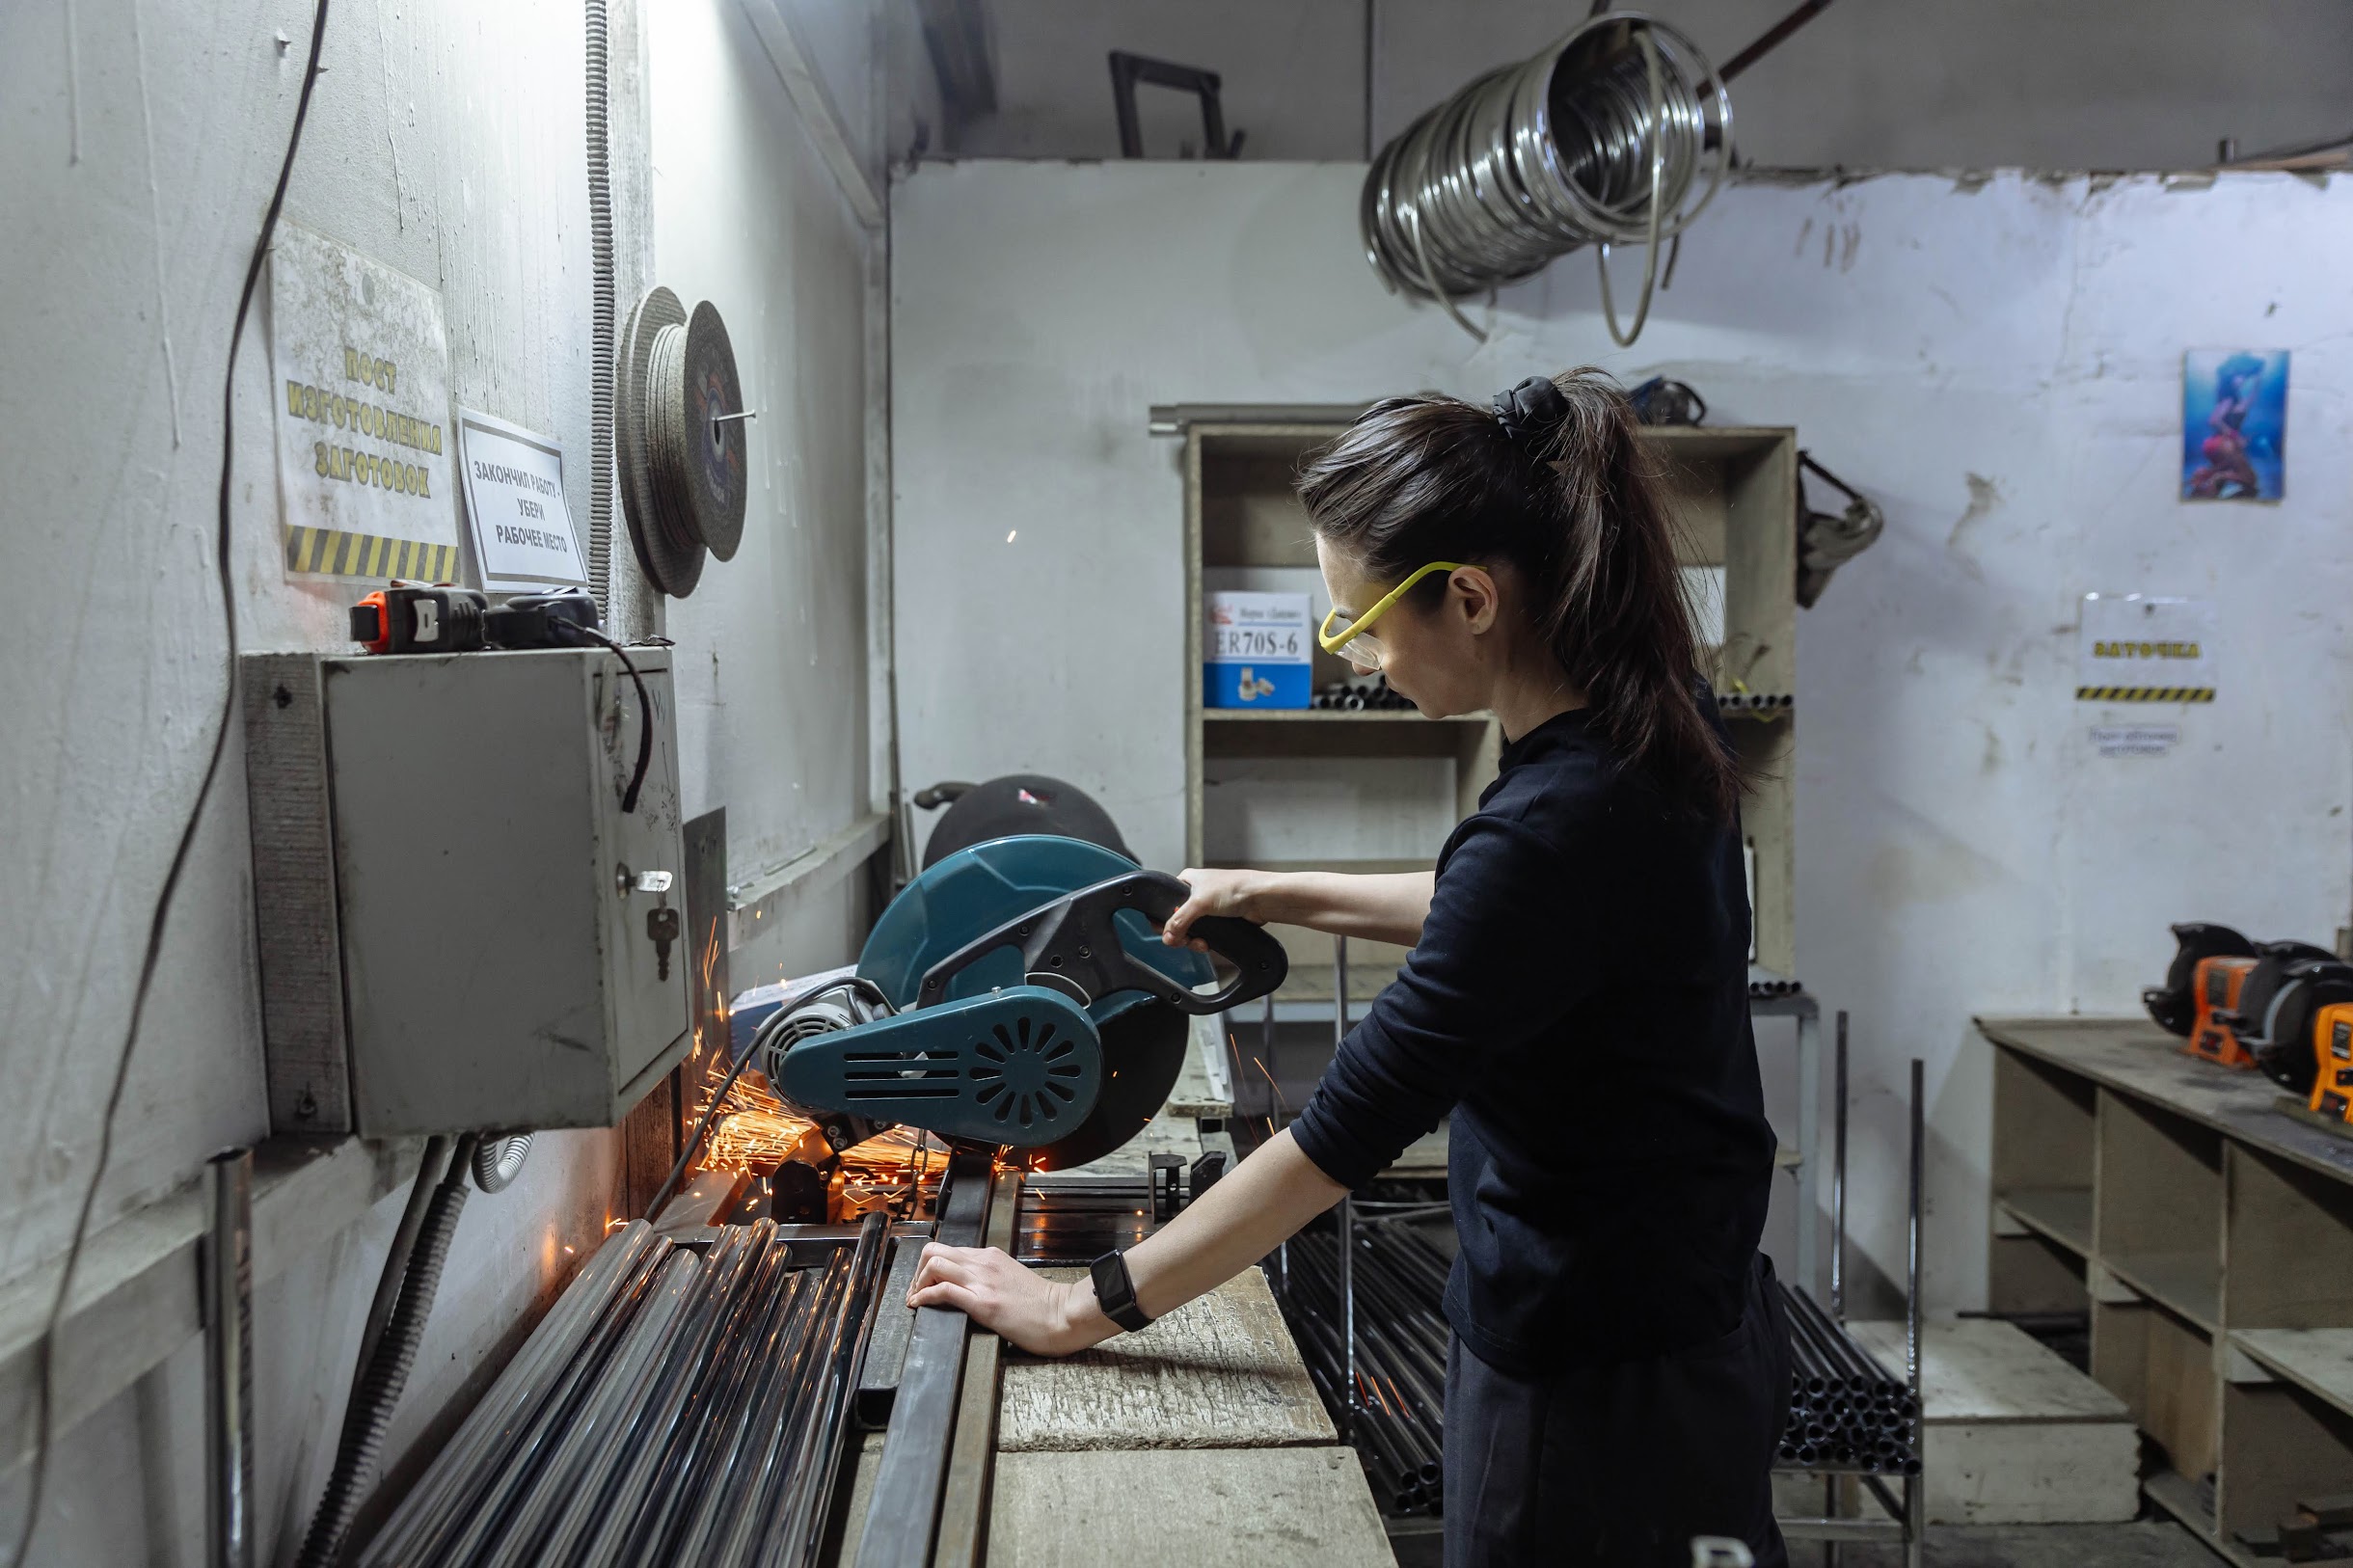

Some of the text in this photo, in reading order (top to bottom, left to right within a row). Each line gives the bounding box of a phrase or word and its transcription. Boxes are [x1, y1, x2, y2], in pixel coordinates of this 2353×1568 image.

[344, 346, 396, 395] ПОСТ
[286, 379, 442, 456] ИЗГОТОВЛЕНИЯ
[314, 441, 431, 499] ЗАГОТОВОК
[473, 460, 530, 490] ЗАКОНЧИЛ
[530, 473, 556, 499] РАБОТУ
[517, 498, 546, 521] УБЕРИ
[496, 525, 568, 554] РАБОЧЕЕ МЕСТО
[1216, 631, 1299, 655] ER70S-6
